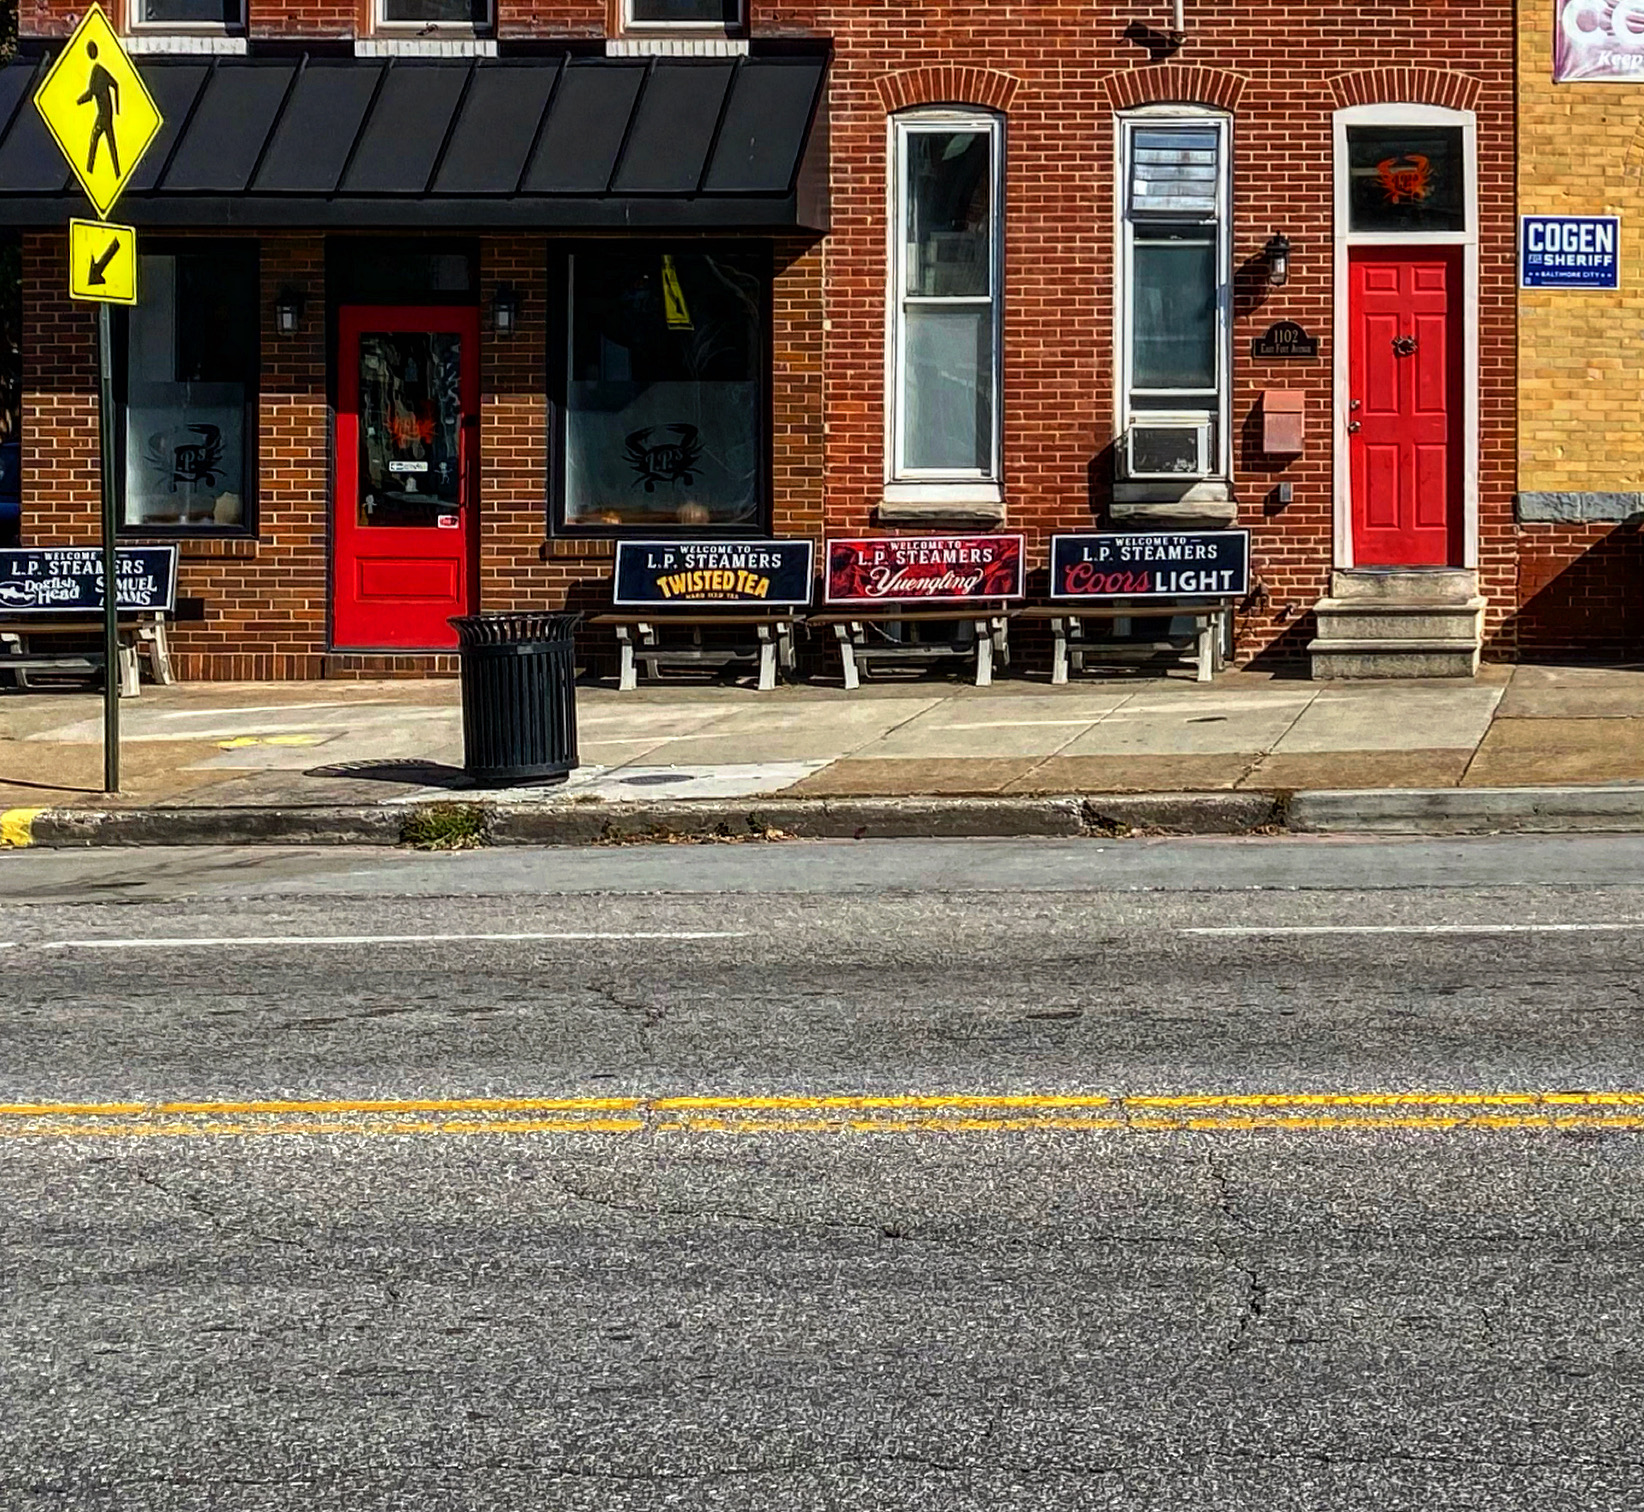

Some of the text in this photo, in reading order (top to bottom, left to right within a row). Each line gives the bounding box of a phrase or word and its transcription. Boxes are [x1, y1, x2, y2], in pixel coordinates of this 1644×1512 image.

[1528, 222, 1613, 253] COGEN
[1543, 253, 1613, 267] SHERIFF
[1274, 329, 1299, 343] 1102
[890, 540, 962, 551] WELCOME TO
[1115, 536, 1187, 547] WELCOME TO
[44, 551, 97, 561] WELCOME
[680, 545, 751, 554] WELCOME TO
[896, 548, 993, 565] STEAMERS
[1083, 544, 1218, 562] L.P. STEAMERS
[11, 561, 42, 576] L.P.
[647, 553, 782, 569] L.P. STEAMERS
[656, 569, 771, 599] TWISTED TEA
[865, 566, 984, 597] Yuengling
[1064, 562, 1235, 594] Coors LIGHT
